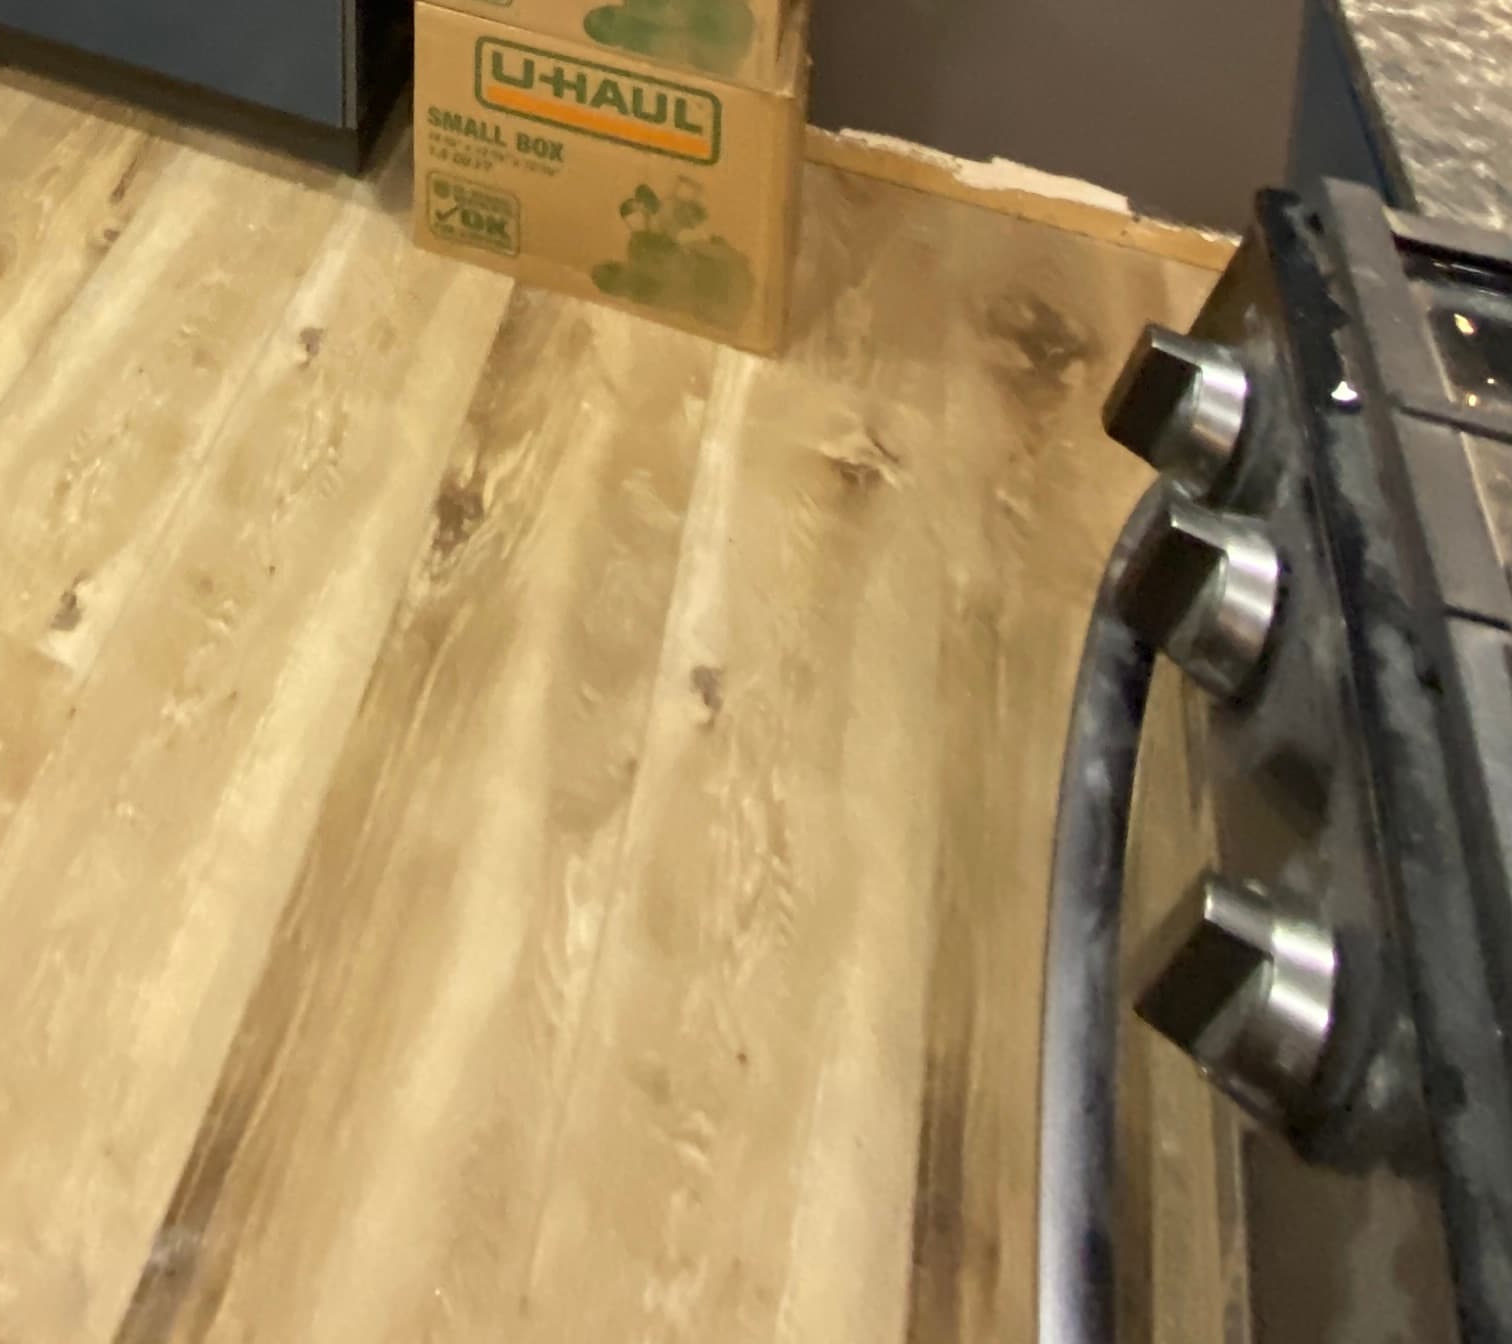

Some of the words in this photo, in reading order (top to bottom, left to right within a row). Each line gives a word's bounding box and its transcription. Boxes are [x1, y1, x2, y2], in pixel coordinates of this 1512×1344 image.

[491, 51, 703, 133] U-HAUL
[428, 106, 507, 147] SMALL
[516, 132, 563, 162] BOX
